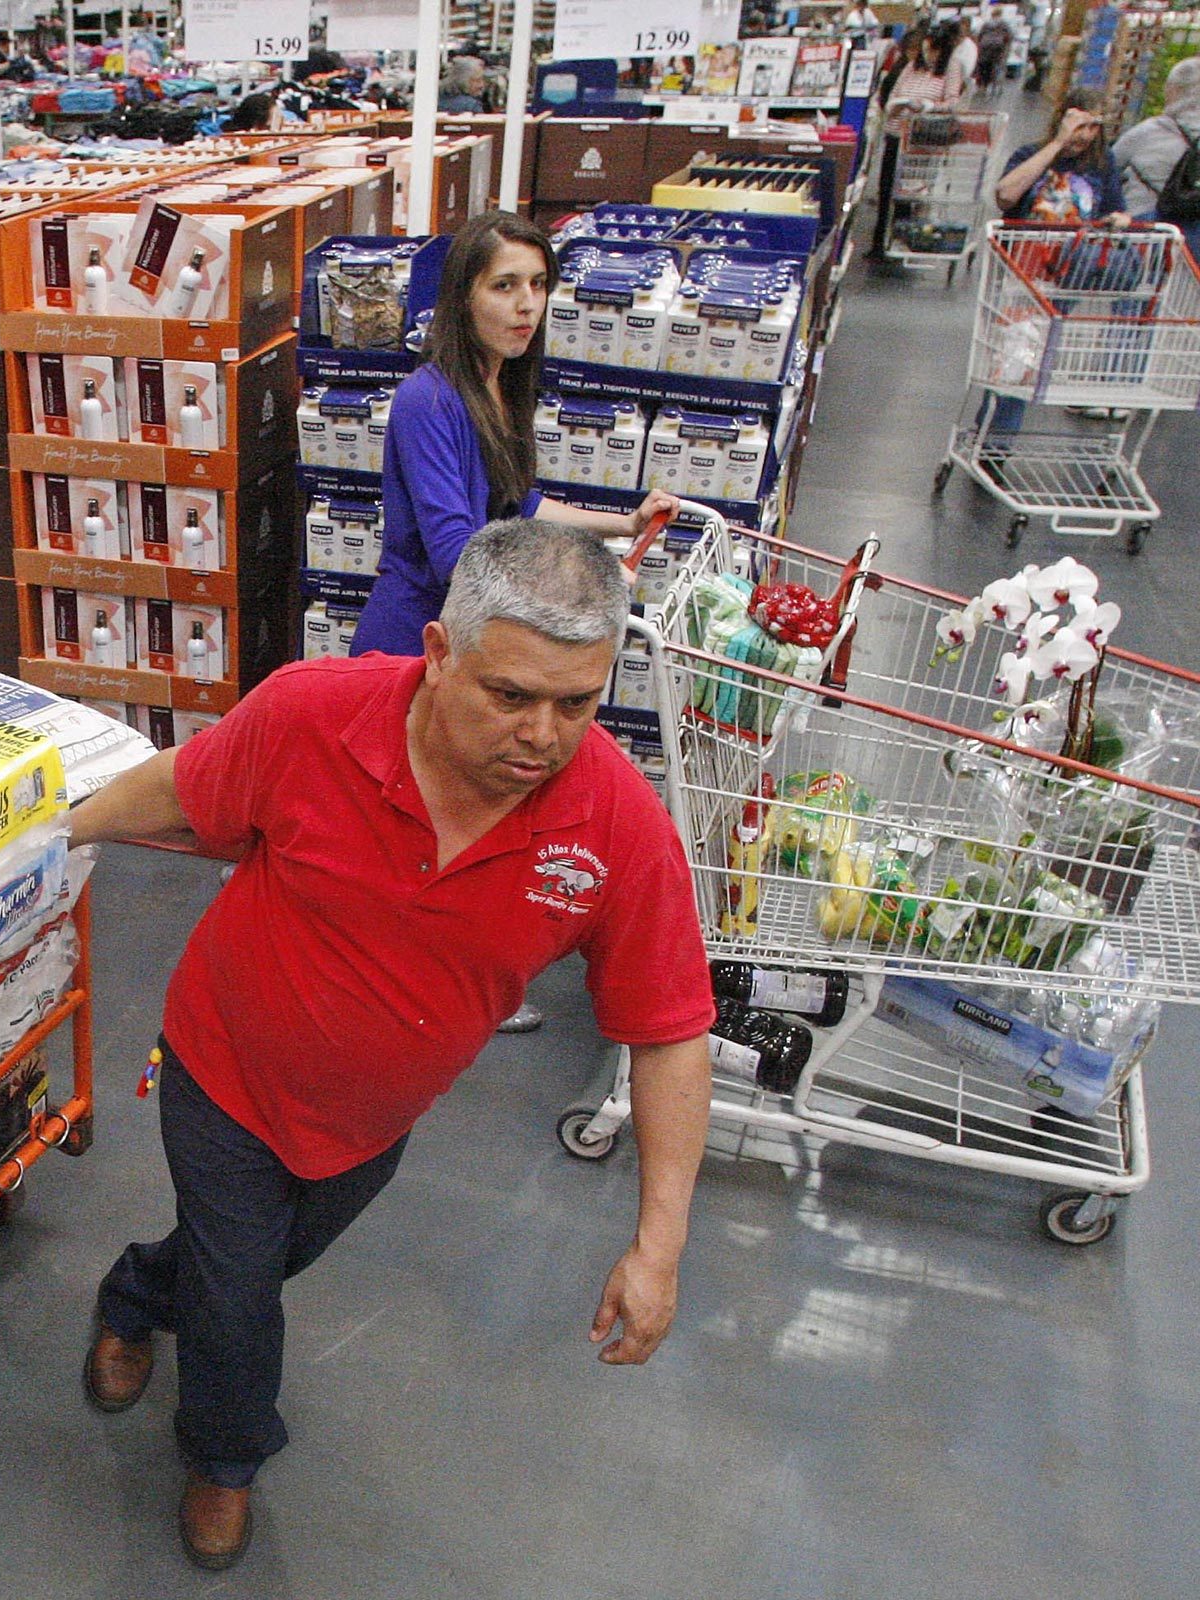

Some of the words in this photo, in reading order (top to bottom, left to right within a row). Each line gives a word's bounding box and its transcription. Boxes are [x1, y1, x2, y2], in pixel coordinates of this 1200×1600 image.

[635, 30, 690, 51] 12.99
[254, 37, 302, 56] 15.99
[553, 309, 578, 319] NIVEA
[590, 321, 613, 331] NIVEA
[628, 316, 654, 328] NIVEA
[672, 323, 699, 335] NIVEA
[711, 338, 735, 347] NIVEA
[751, 332, 779, 343] NIVEA
[319, 368, 340, 377] FIRMS
[341, 369, 357, 377] AND
[358, 370, 394, 379] TIGHTENS
[559, 379, 581, 389] FIRMS
[584, 382, 601, 390] AND
[602, 383, 641, 395] TIGHTENS
[665, 391, 699, 403] RESULTS
[700, 396, 711, 405] IN
[712, 396, 732, 406] JUST
[302, 422, 325, 431] NIVEA
[537, 432, 562, 443] NIVEA
[608, 438, 634, 449] NIVEA
[571, 445, 594, 454] NIVEA
[654, 443, 681, 455] NIVEA
[691, 456, 715, 467] NIVEA
[730, 451, 758, 462] NIVEA
[318, 483, 338, 491] FIRMS
[585, 502, 622, 514] TIGHTENS
[311, 526, 333, 535] NIVEA
[344, 538, 364, 546] NIVEA
[642, 559, 667, 567] NIVEA
[320, 587, 341, 596] FIRMS
[342, 589, 357, 597] AND
[309, 622, 330, 632] NIVEA
[624, 661, 648, 671] NIVEA
[618, 722, 648, 731] RESULTS
[645, 773, 664, 781] NIVEA
[958, 1001, 1011, 1031] KIRKLAND
